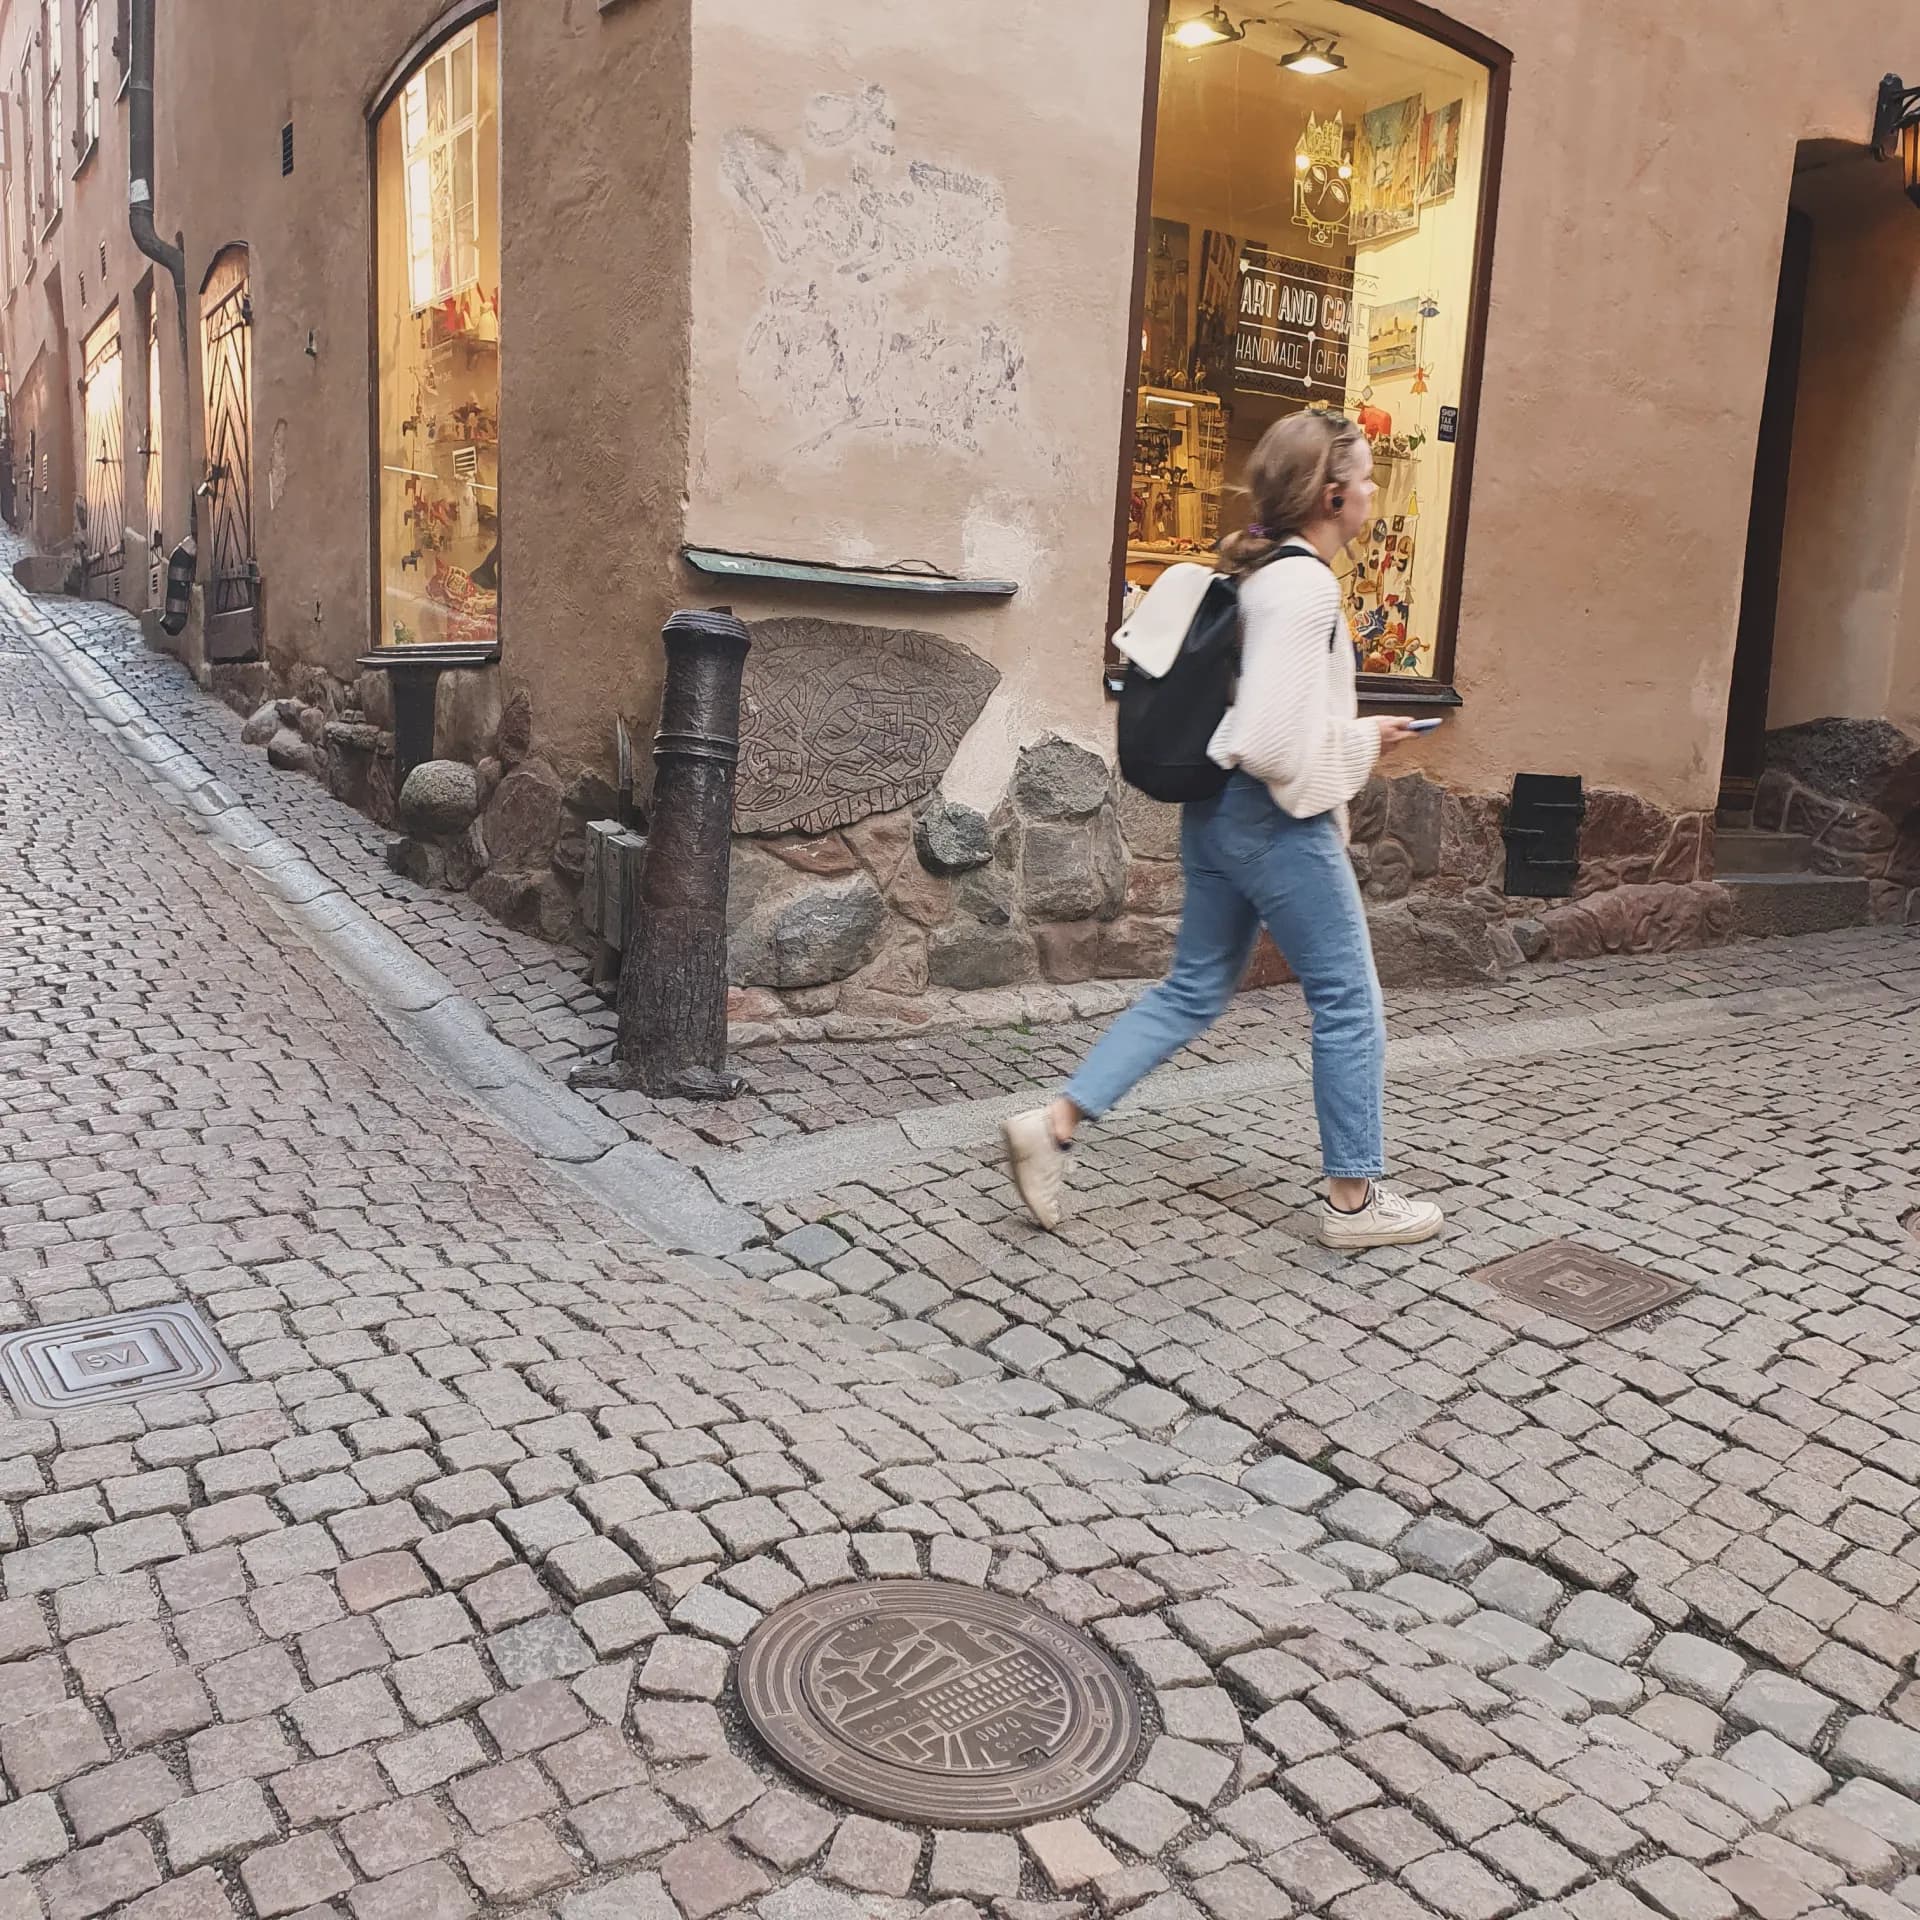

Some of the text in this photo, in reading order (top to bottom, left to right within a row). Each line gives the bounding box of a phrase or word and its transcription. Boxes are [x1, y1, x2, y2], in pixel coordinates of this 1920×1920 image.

[1240, 276, 1375, 341] ART AND CRAF
[1235, 332, 1304, 370] HANDMADE
[1315, 349, 1347, 379] GIFTS
[1440, 423, 1454, 433] FREE
[1441, 415, 1452, 424] TAX
[85, 1347, 131, 1369] SV
